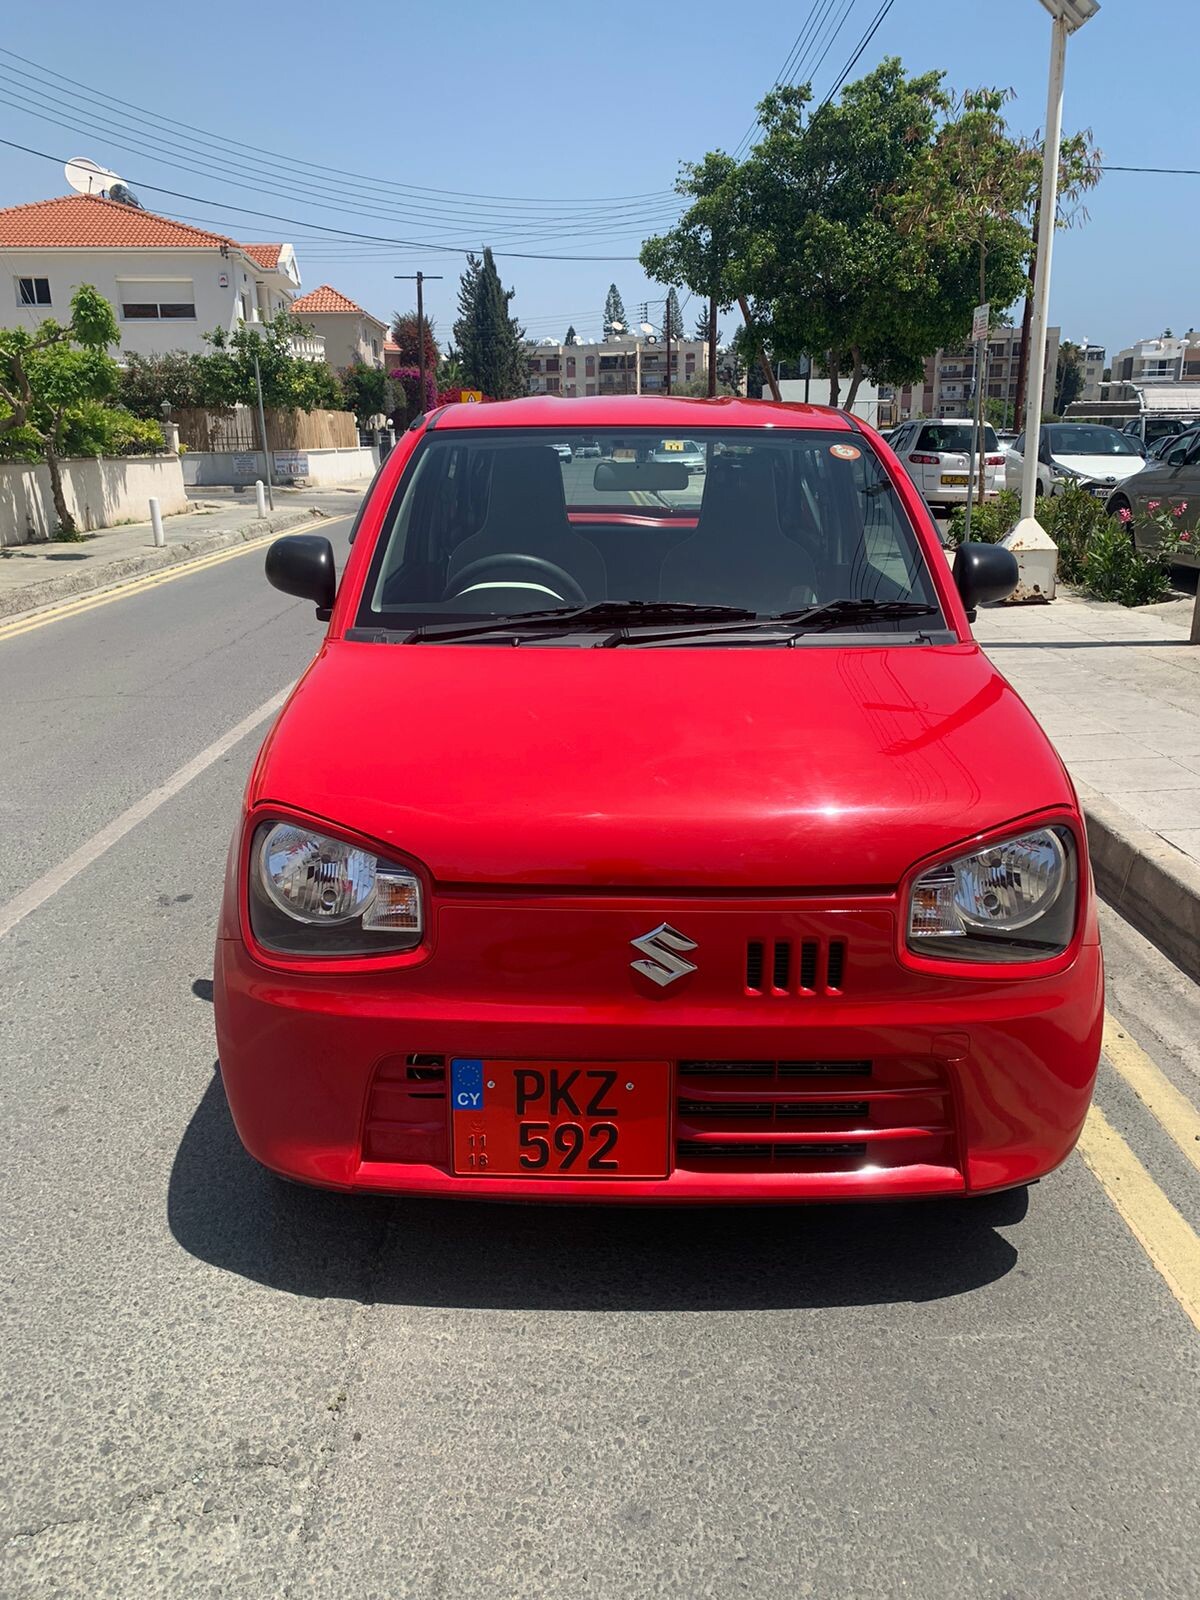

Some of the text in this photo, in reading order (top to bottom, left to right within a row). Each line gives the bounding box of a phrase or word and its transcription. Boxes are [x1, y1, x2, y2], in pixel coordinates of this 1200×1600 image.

[457, 1092, 481, 1106] CY
[513, 1069, 619, 1116] PKZ
[468, 1134, 487, 1148] 11
[519, 1121, 619, 1170] 592
